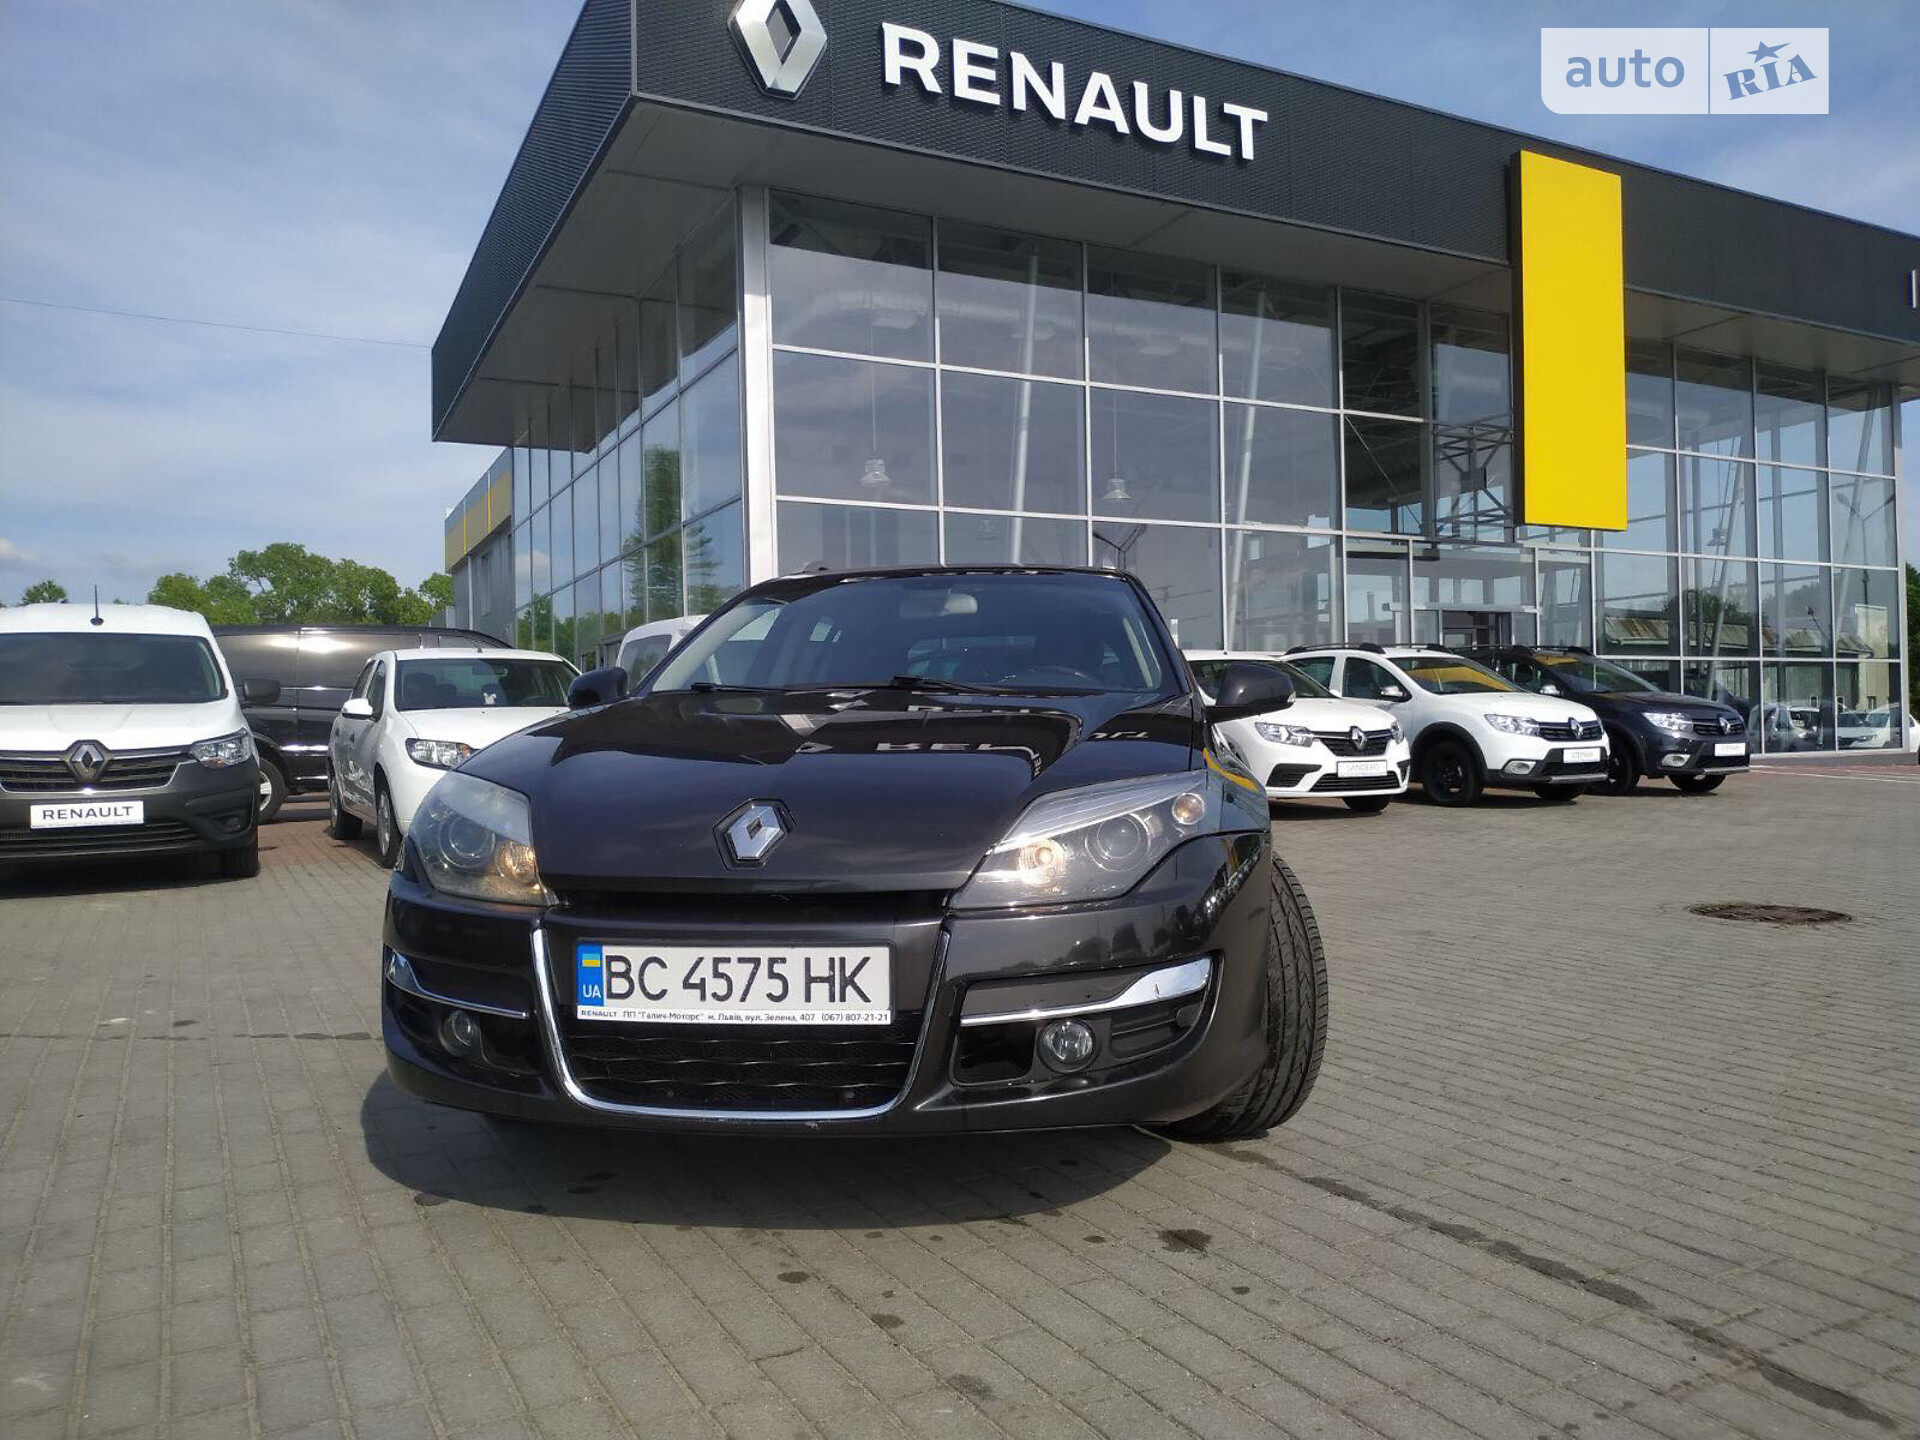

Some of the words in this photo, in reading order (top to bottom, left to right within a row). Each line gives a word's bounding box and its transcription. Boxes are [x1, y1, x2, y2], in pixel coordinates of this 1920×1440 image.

[881, 22, 1268, 161] RENAULT
[42, 806, 133, 820] RENAULT
[605, 955, 668, 1002] BC
[682, 956, 789, 1003] 4575
[804, 956, 871, 1003] HK
[582, 984, 602, 998] UA
[581, 1010, 617, 1018] RENAULT
[623, 1010, 637, 1018] ПП
[800, 1013, 816, 1021] 407
[822, 1013, 843, 1021] (067)
[845, 1013, 888, 1021] 807-21-21
